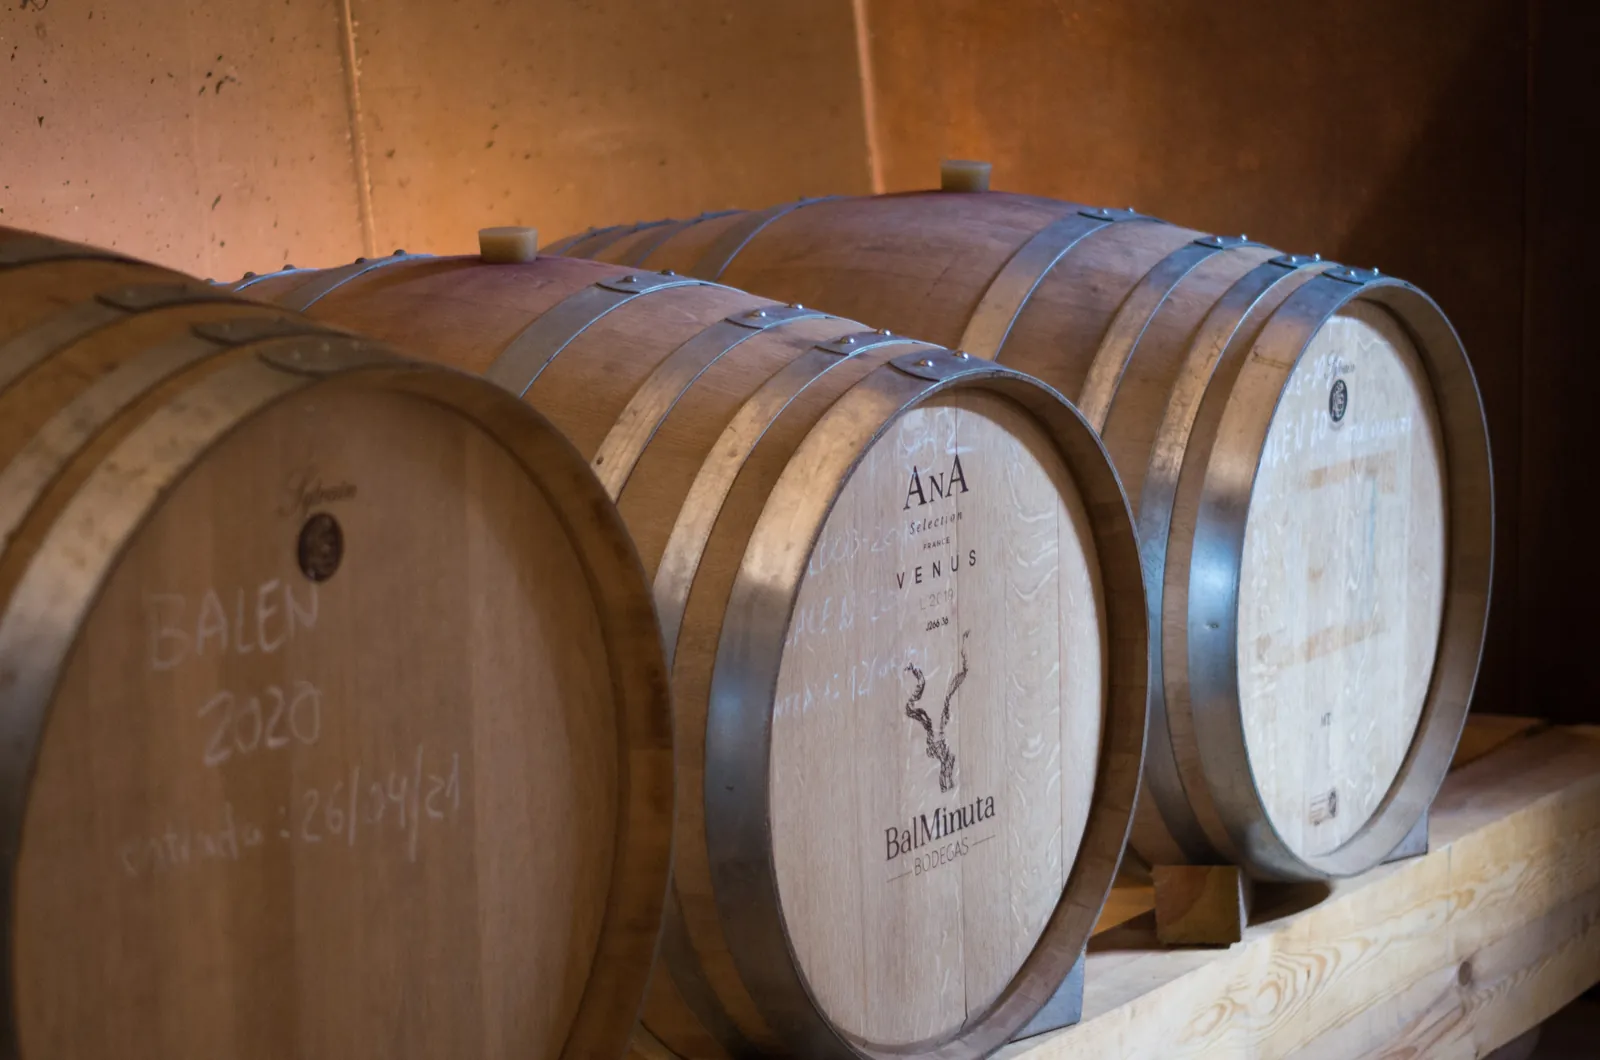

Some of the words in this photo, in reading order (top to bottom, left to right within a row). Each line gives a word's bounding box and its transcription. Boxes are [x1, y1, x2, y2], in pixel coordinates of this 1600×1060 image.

[896, 549, 977, 591] VENUS
[923, 536, 951, 551] FRANCE
[143, 578, 319, 671] BALEN
[197, 680, 322, 767] 2020
[884, 795, 996, 862] BalMinuta
[914, 836, 970, 876] BODEGAS
